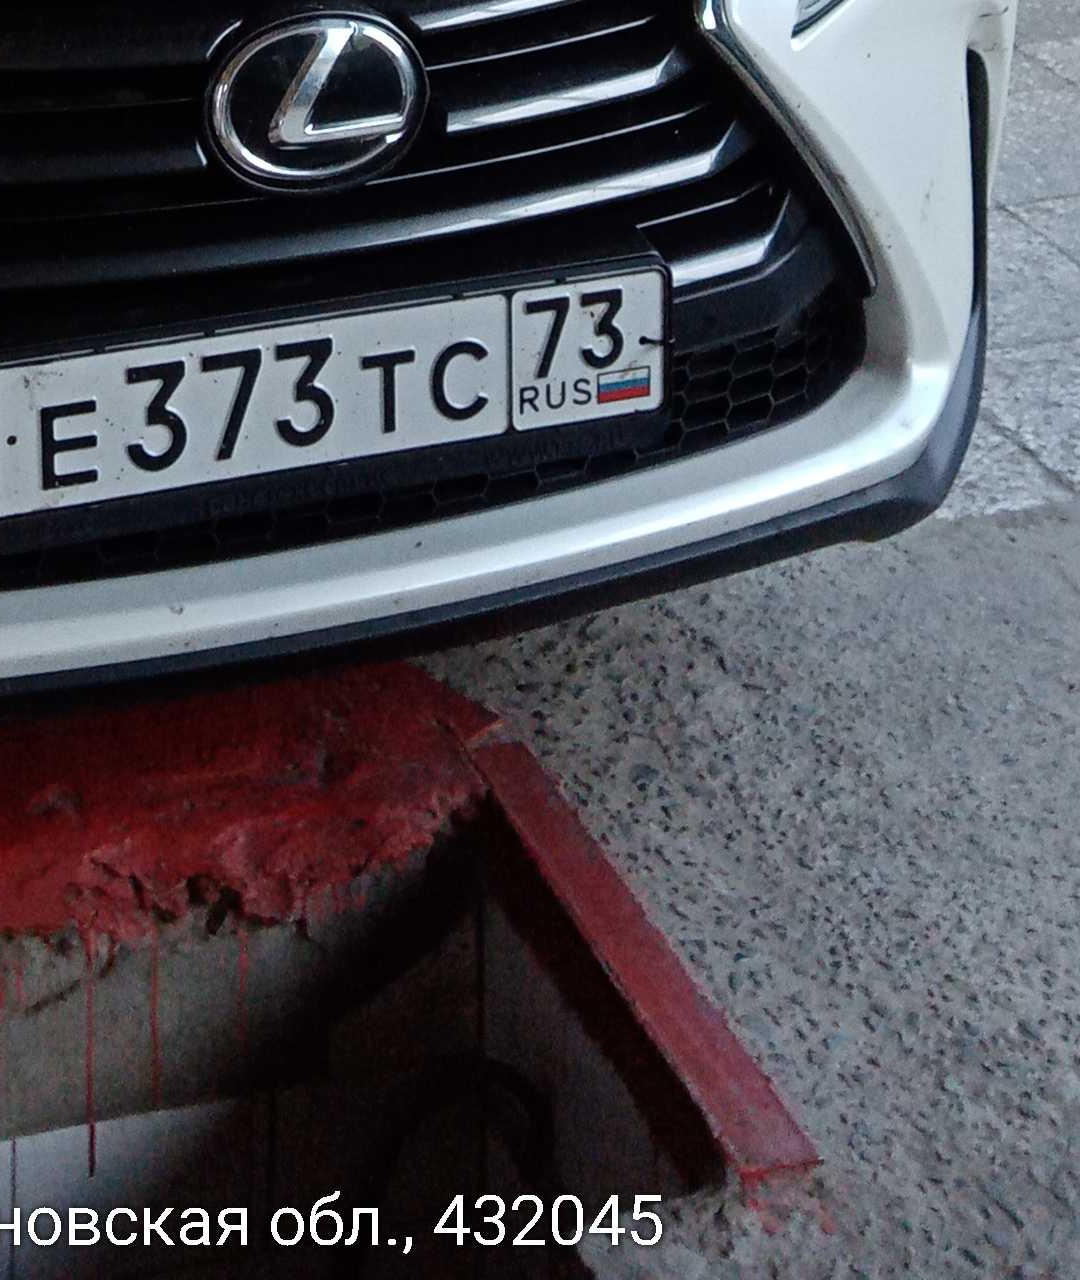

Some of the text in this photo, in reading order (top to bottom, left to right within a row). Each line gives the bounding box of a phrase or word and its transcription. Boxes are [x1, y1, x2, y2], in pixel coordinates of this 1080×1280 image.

[524, 288, 624, 379] 73
[39, 337, 488, 491] Е373ТС
[520, 379, 592, 415] RUS
